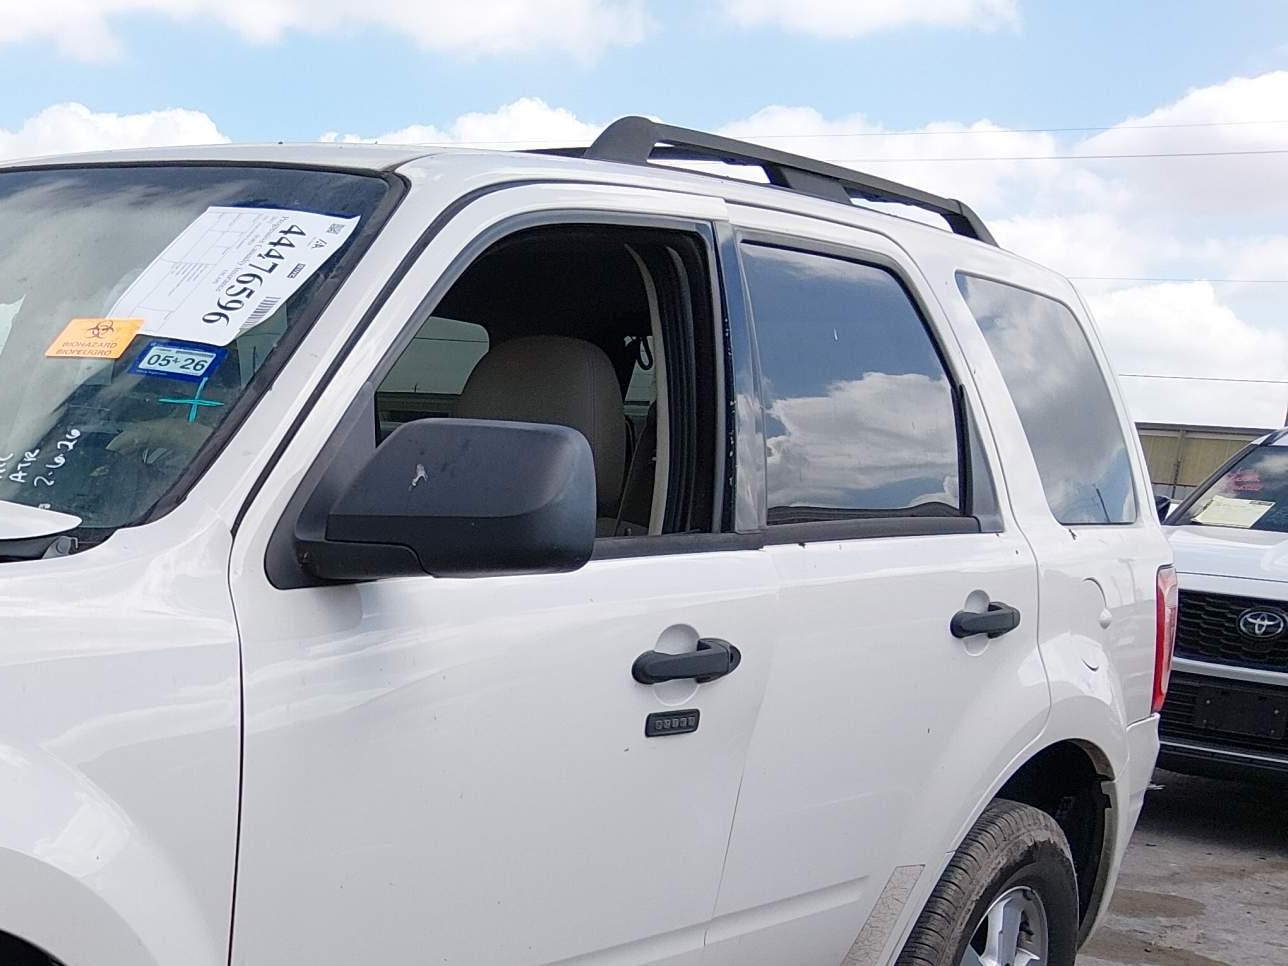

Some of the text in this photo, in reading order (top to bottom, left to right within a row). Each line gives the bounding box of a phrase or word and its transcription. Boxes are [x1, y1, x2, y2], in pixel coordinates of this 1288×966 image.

[202, 223, 306, 327] 44476596
[62, 341, 118, 349] BIOHAZARD
[147, 354, 208, 372] 05 26
